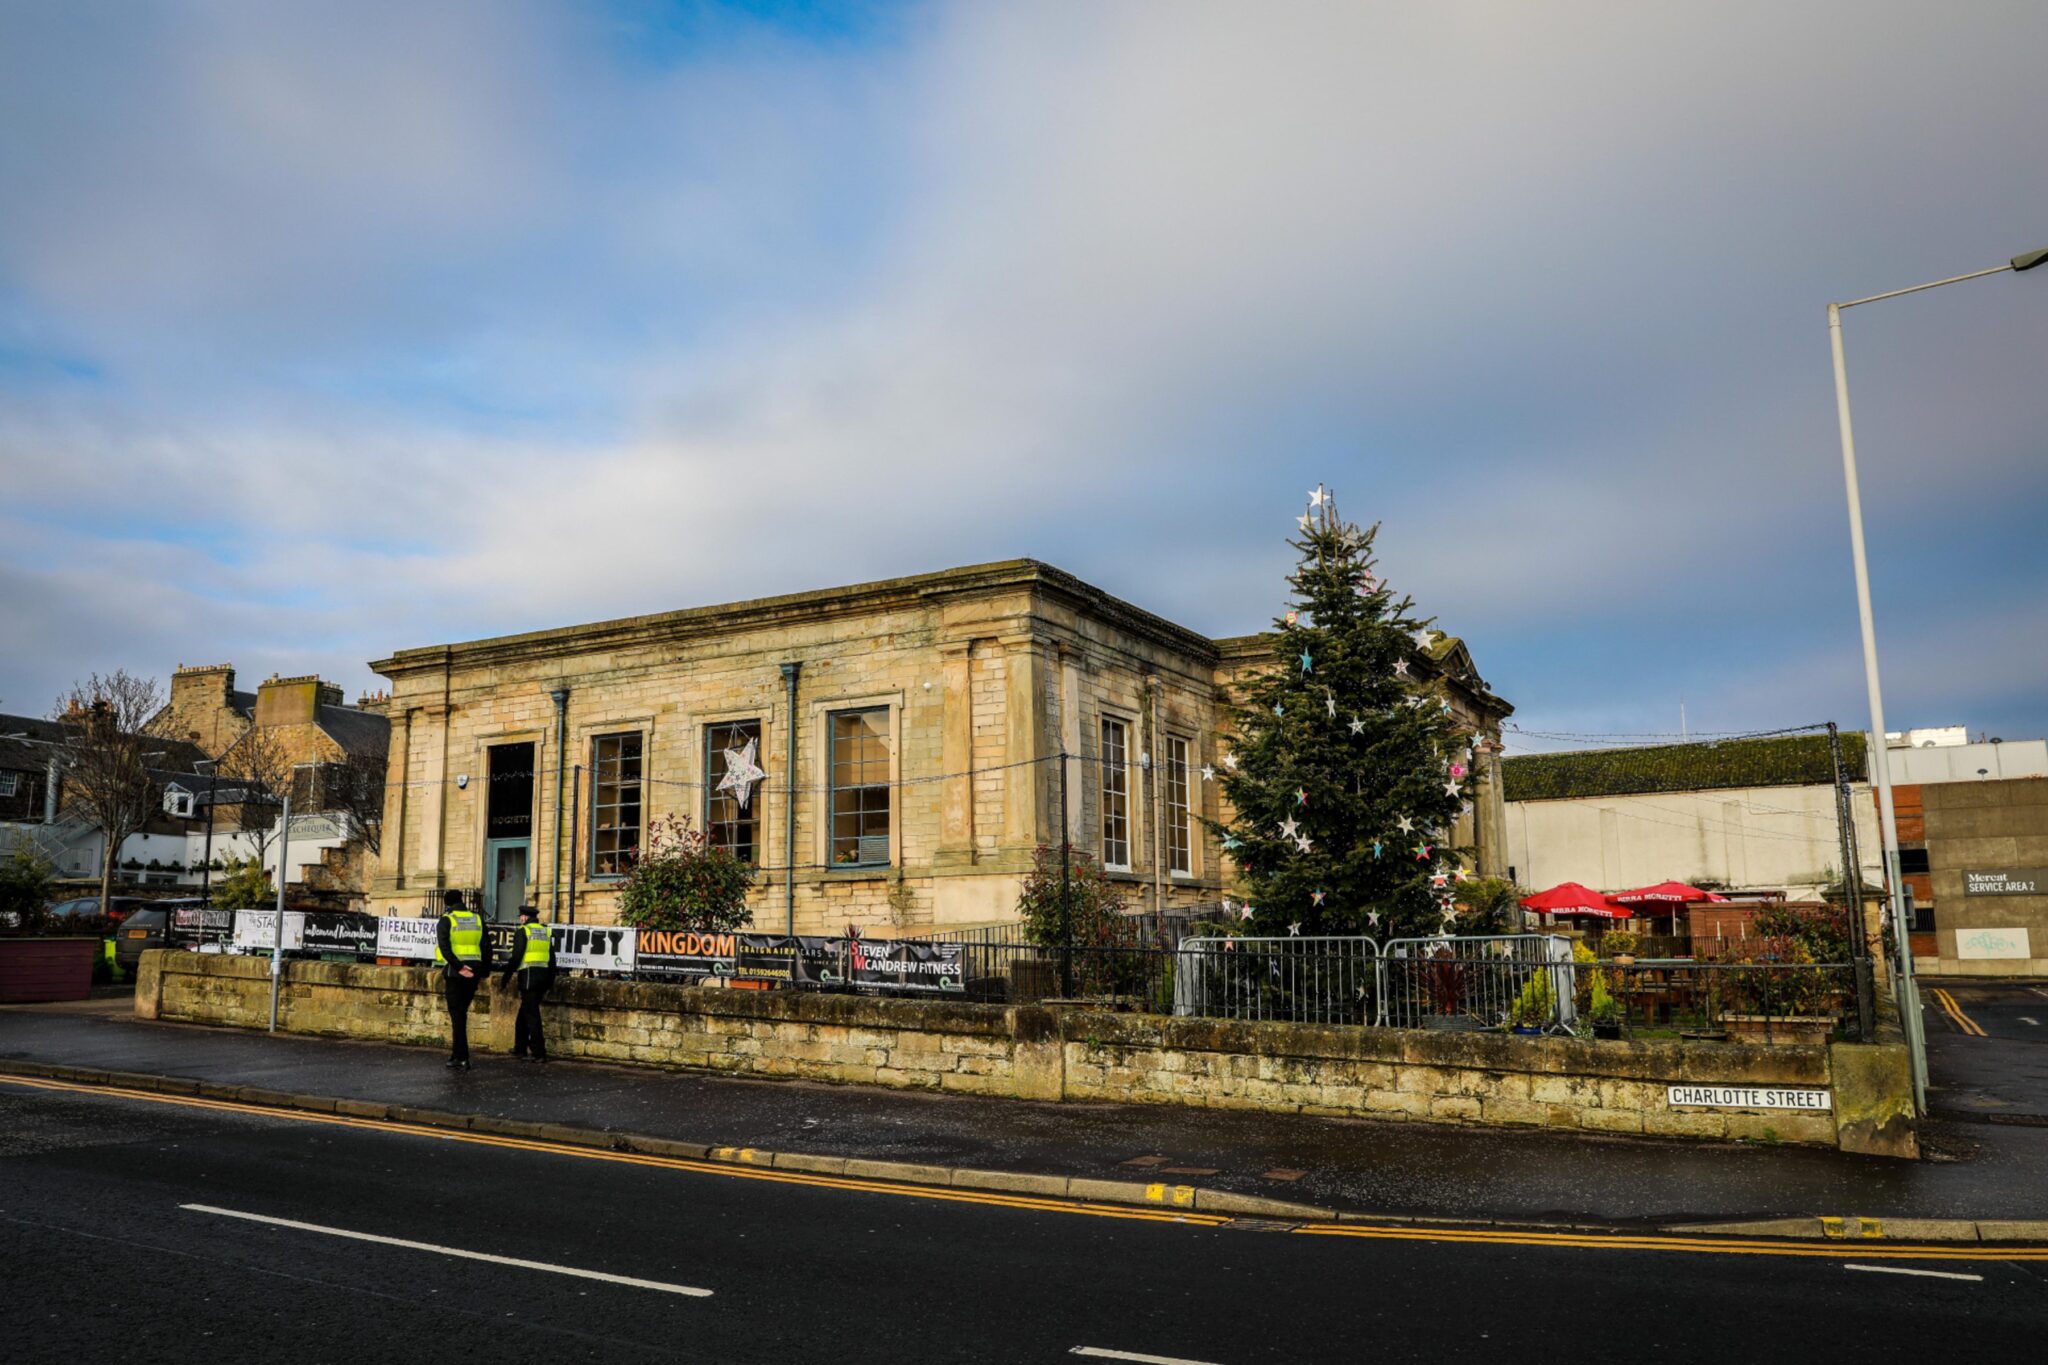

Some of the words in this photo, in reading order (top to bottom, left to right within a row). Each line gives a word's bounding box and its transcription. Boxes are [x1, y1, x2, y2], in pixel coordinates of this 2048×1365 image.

[1968, 873, 2008, 882] Mercat
[1969, 882, 2004, 892] SERVICE
[2005, 881, 2028, 891] AREA
[2029, 881, 2035, 891] 2
[1644, 893, 1683, 901] MORETTI
[1577, 906, 1613, 918] MORETTI
[379, 918, 437, 935] FIFEALLTRA
[411, 935, 431, 945] Trades
[551, 928, 624, 956] TIPSY
[639, 930, 736, 958] KINGDOM
[800, 948, 822, 958] CARS
[851, 940, 889, 958] STEVEN
[738, 966, 748, 976] TEL
[854, 955, 917, 974] MCANDREW
[919, 961, 961, 975] FITNESS
[1673, 1088, 1761, 1105] CHARLOTTE
[1766, 1091, 1825, 1107] STREET
